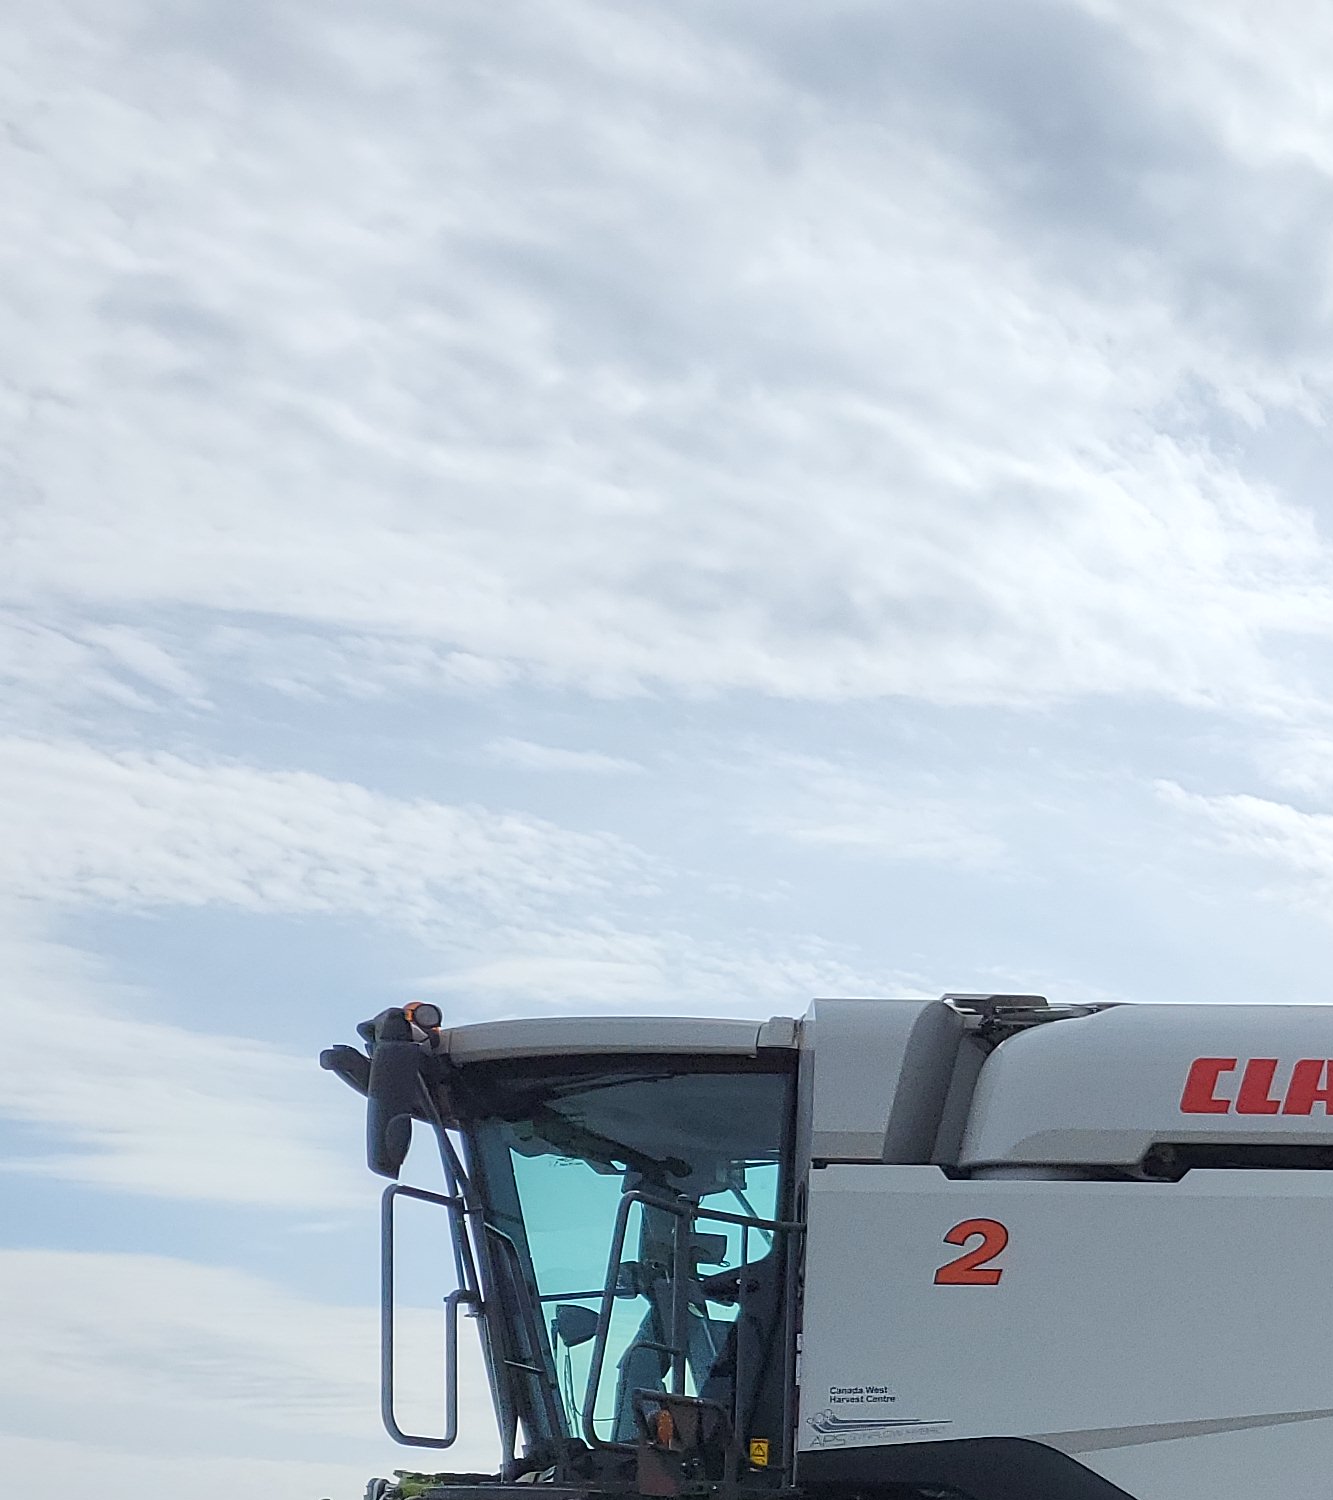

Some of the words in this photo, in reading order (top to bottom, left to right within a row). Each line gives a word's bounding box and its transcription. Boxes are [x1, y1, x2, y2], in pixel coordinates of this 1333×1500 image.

[933, 1218, 1008, 1285] 2
[829, 1386, 864, 1394] Canada
[866, 1386, 888, 1394] West
[829, 1395, 864, 1403] Harvest
[866, 1395, 896, 1403] Centre
